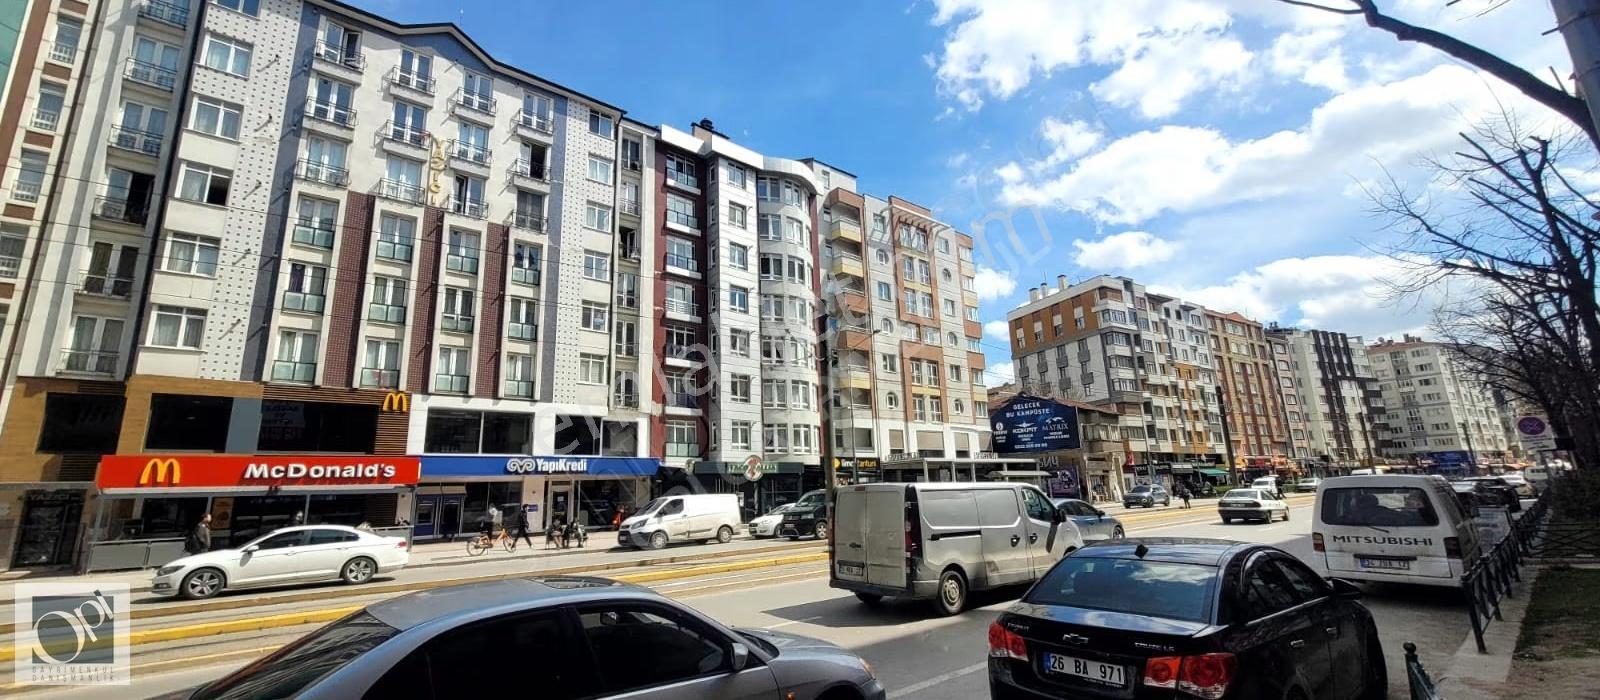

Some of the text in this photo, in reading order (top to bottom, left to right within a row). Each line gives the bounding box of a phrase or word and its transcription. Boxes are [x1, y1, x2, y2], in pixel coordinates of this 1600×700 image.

[244, 463, 396, 479] McDonald's
[1332, 535, 1433, 546] MITSUBISHI
[1051, 656, 1064, 670] 26
[1074, 659, 1089, 675] BA
[1100, 664, 1122, 682] 971
